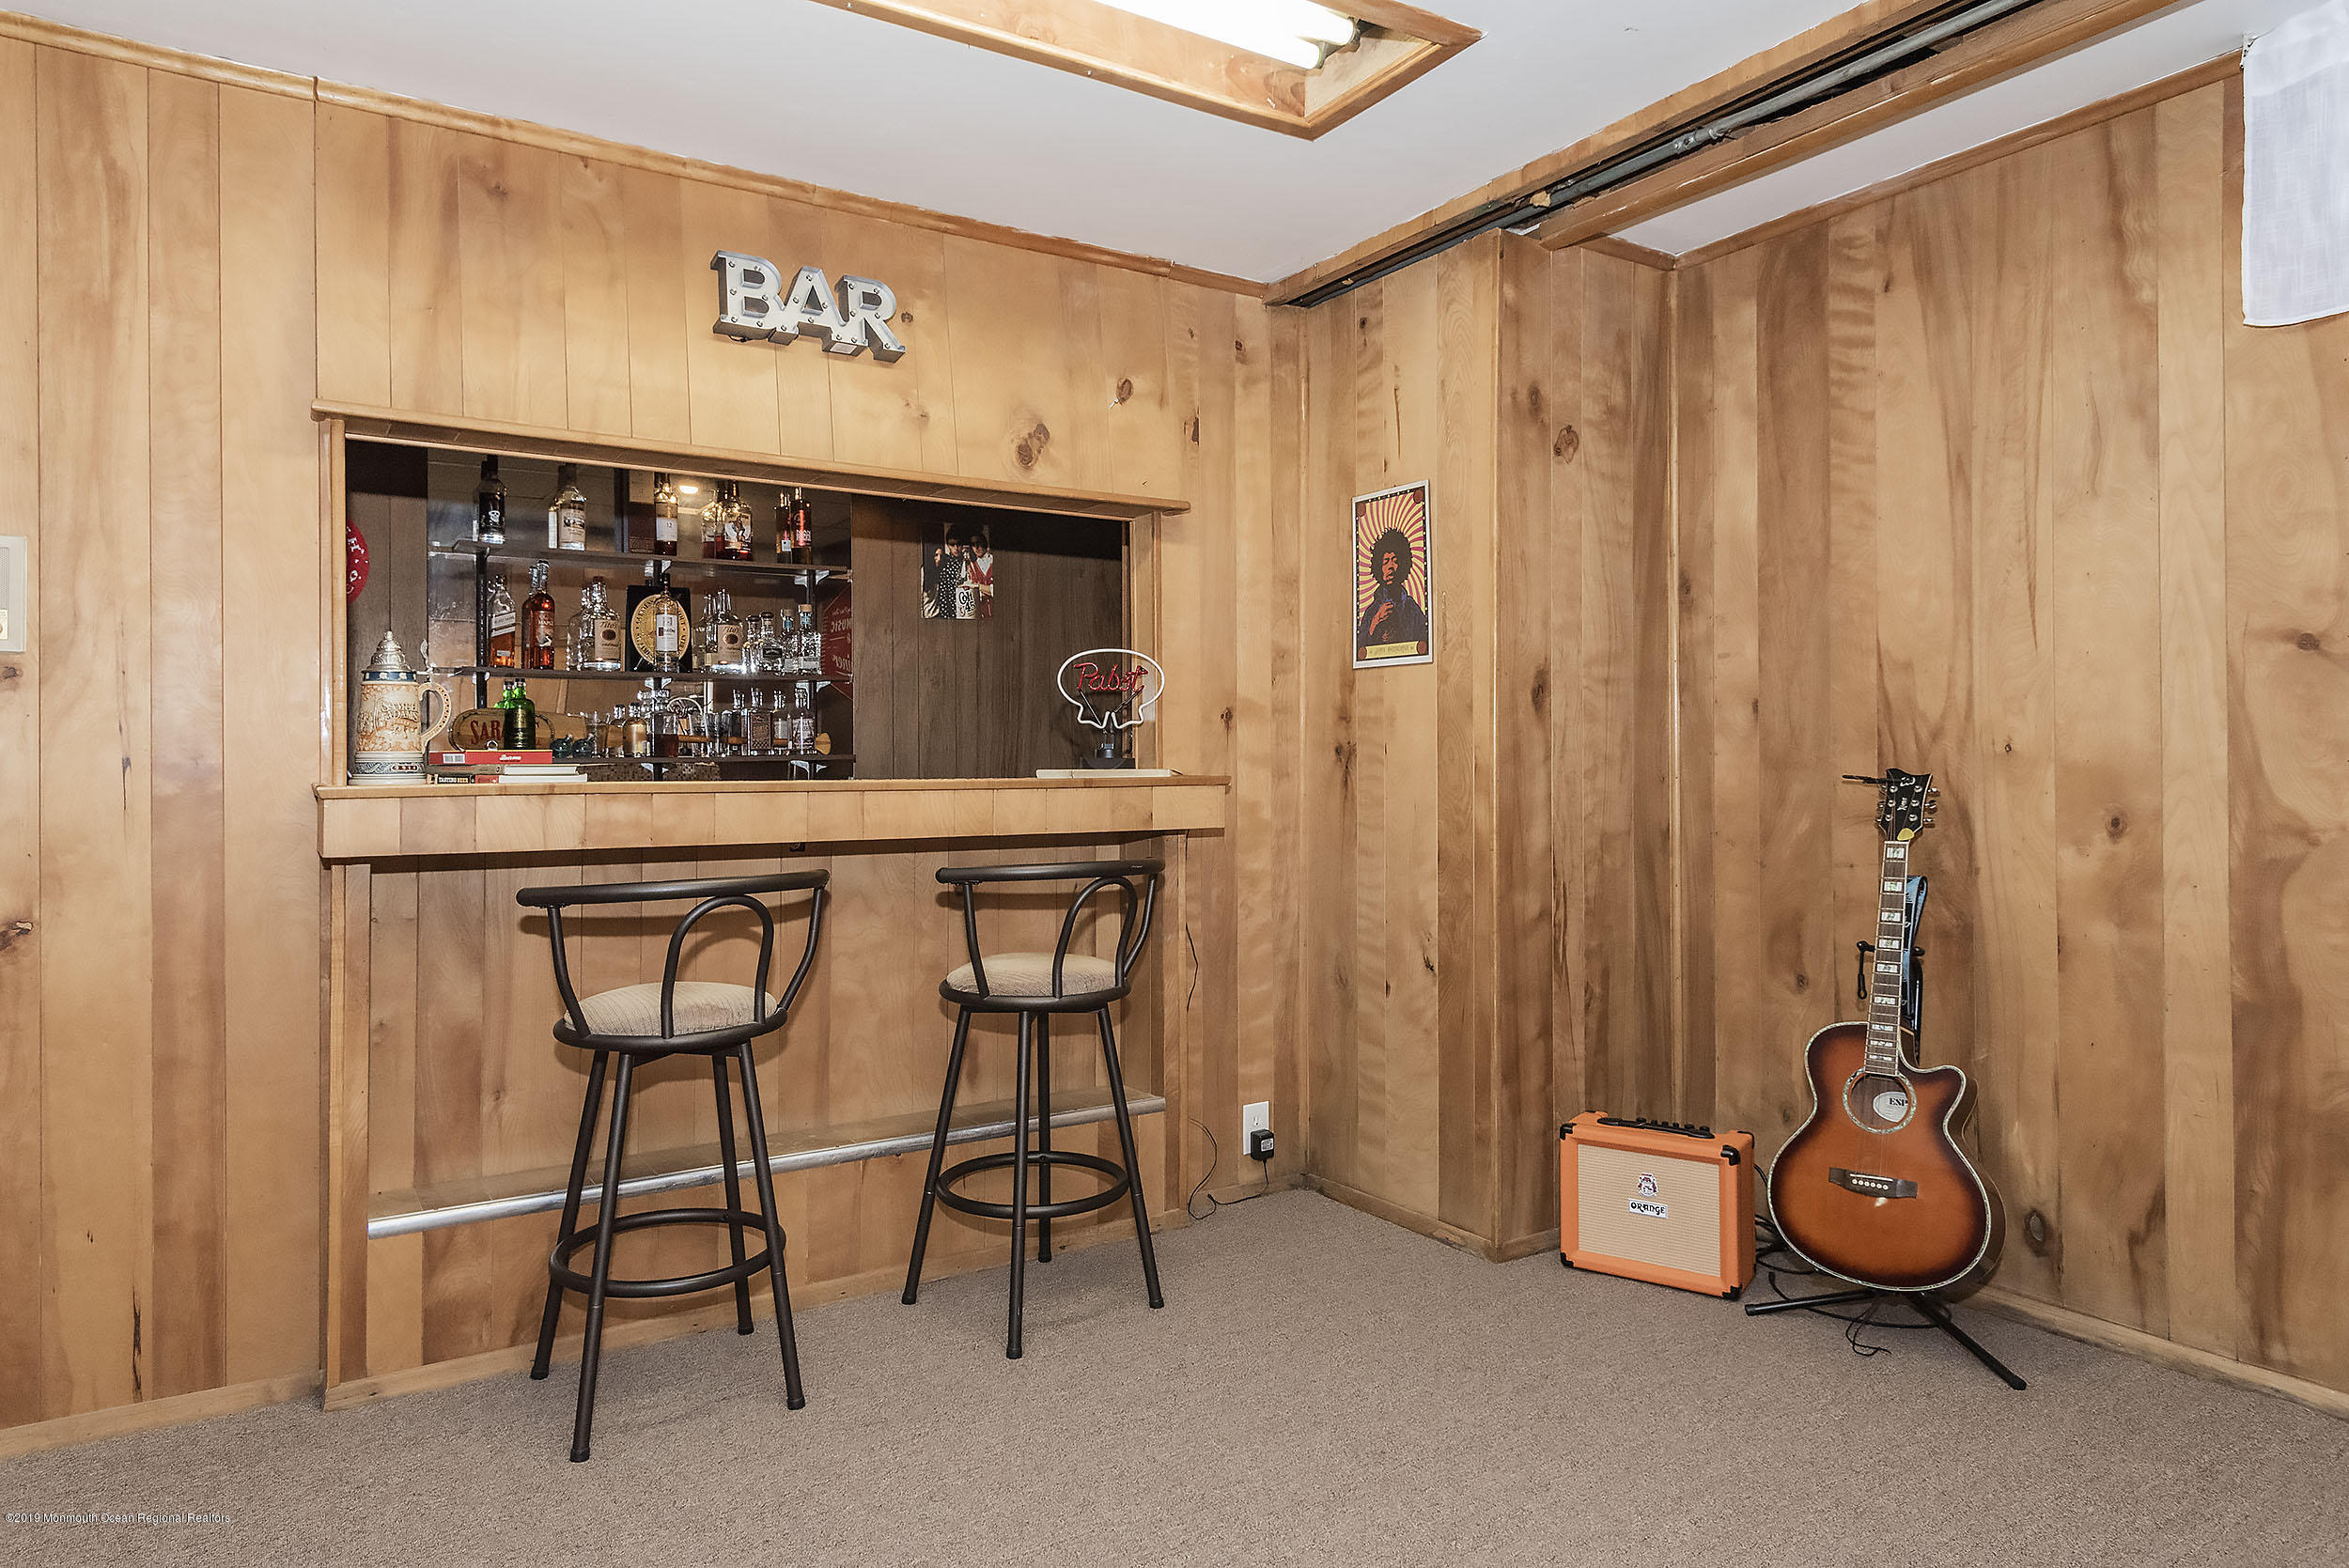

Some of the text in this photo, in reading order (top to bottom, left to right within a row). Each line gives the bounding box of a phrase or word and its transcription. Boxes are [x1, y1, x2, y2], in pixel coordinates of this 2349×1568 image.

[711, 250, 906, 363] BAR
[958, 590, 973, 604] Colt
[966, 601, 976, 613] 45
[1074, 661, 1148, 692] Pabst
[471, 720, 505, 745] SAR
[1890, 1097, 1908, 1107] ESP
[1631, 1203, 1665, 1215] ORANGE
